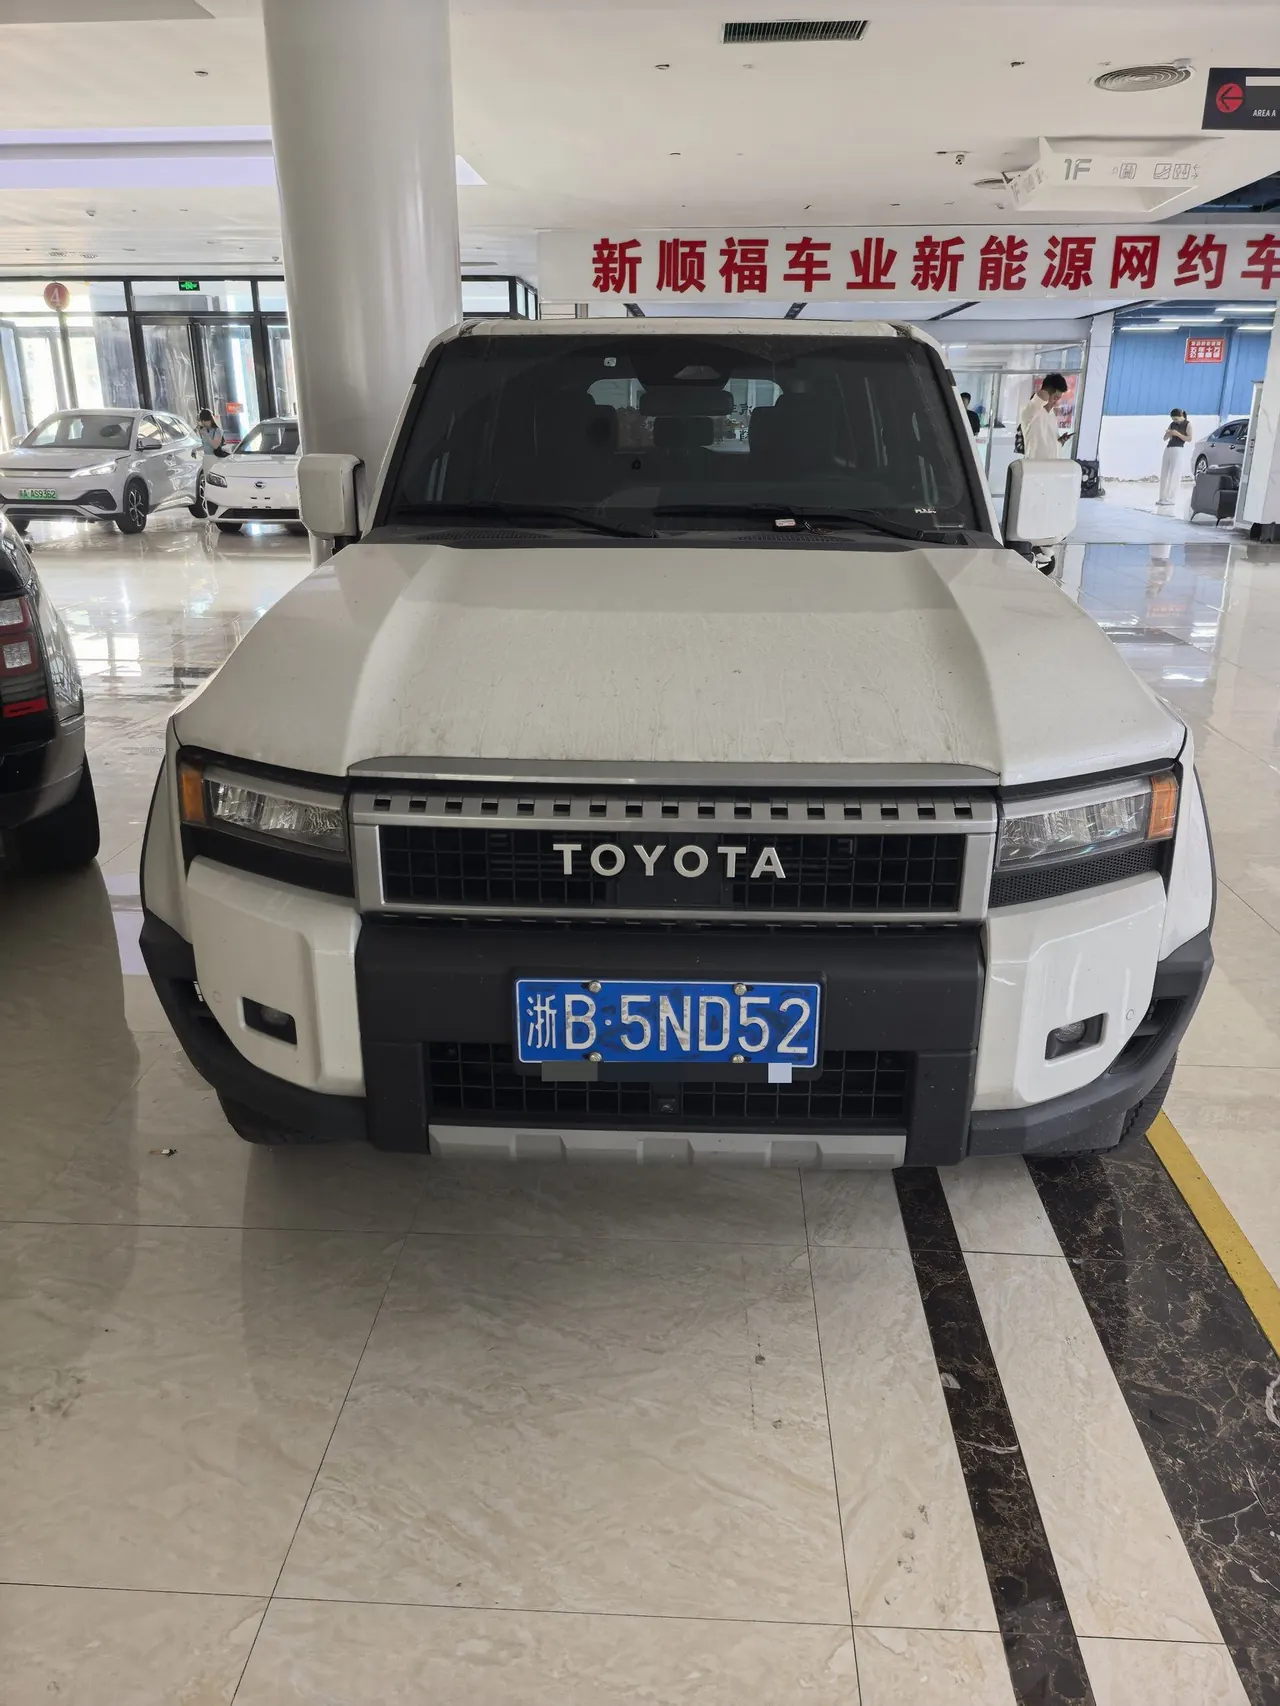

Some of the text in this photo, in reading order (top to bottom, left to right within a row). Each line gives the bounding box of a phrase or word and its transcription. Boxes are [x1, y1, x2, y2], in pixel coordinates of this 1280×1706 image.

[1252, 109, 1277, 117] AREA A
[1063, 158, 1093, 181] 1F
[592, 233, 1280, 294] 新顺福车业新能源网约车
[553, 843, 786, 879] TOYOTA
[527, 993, 811, 1054] 浙B·5ND52
